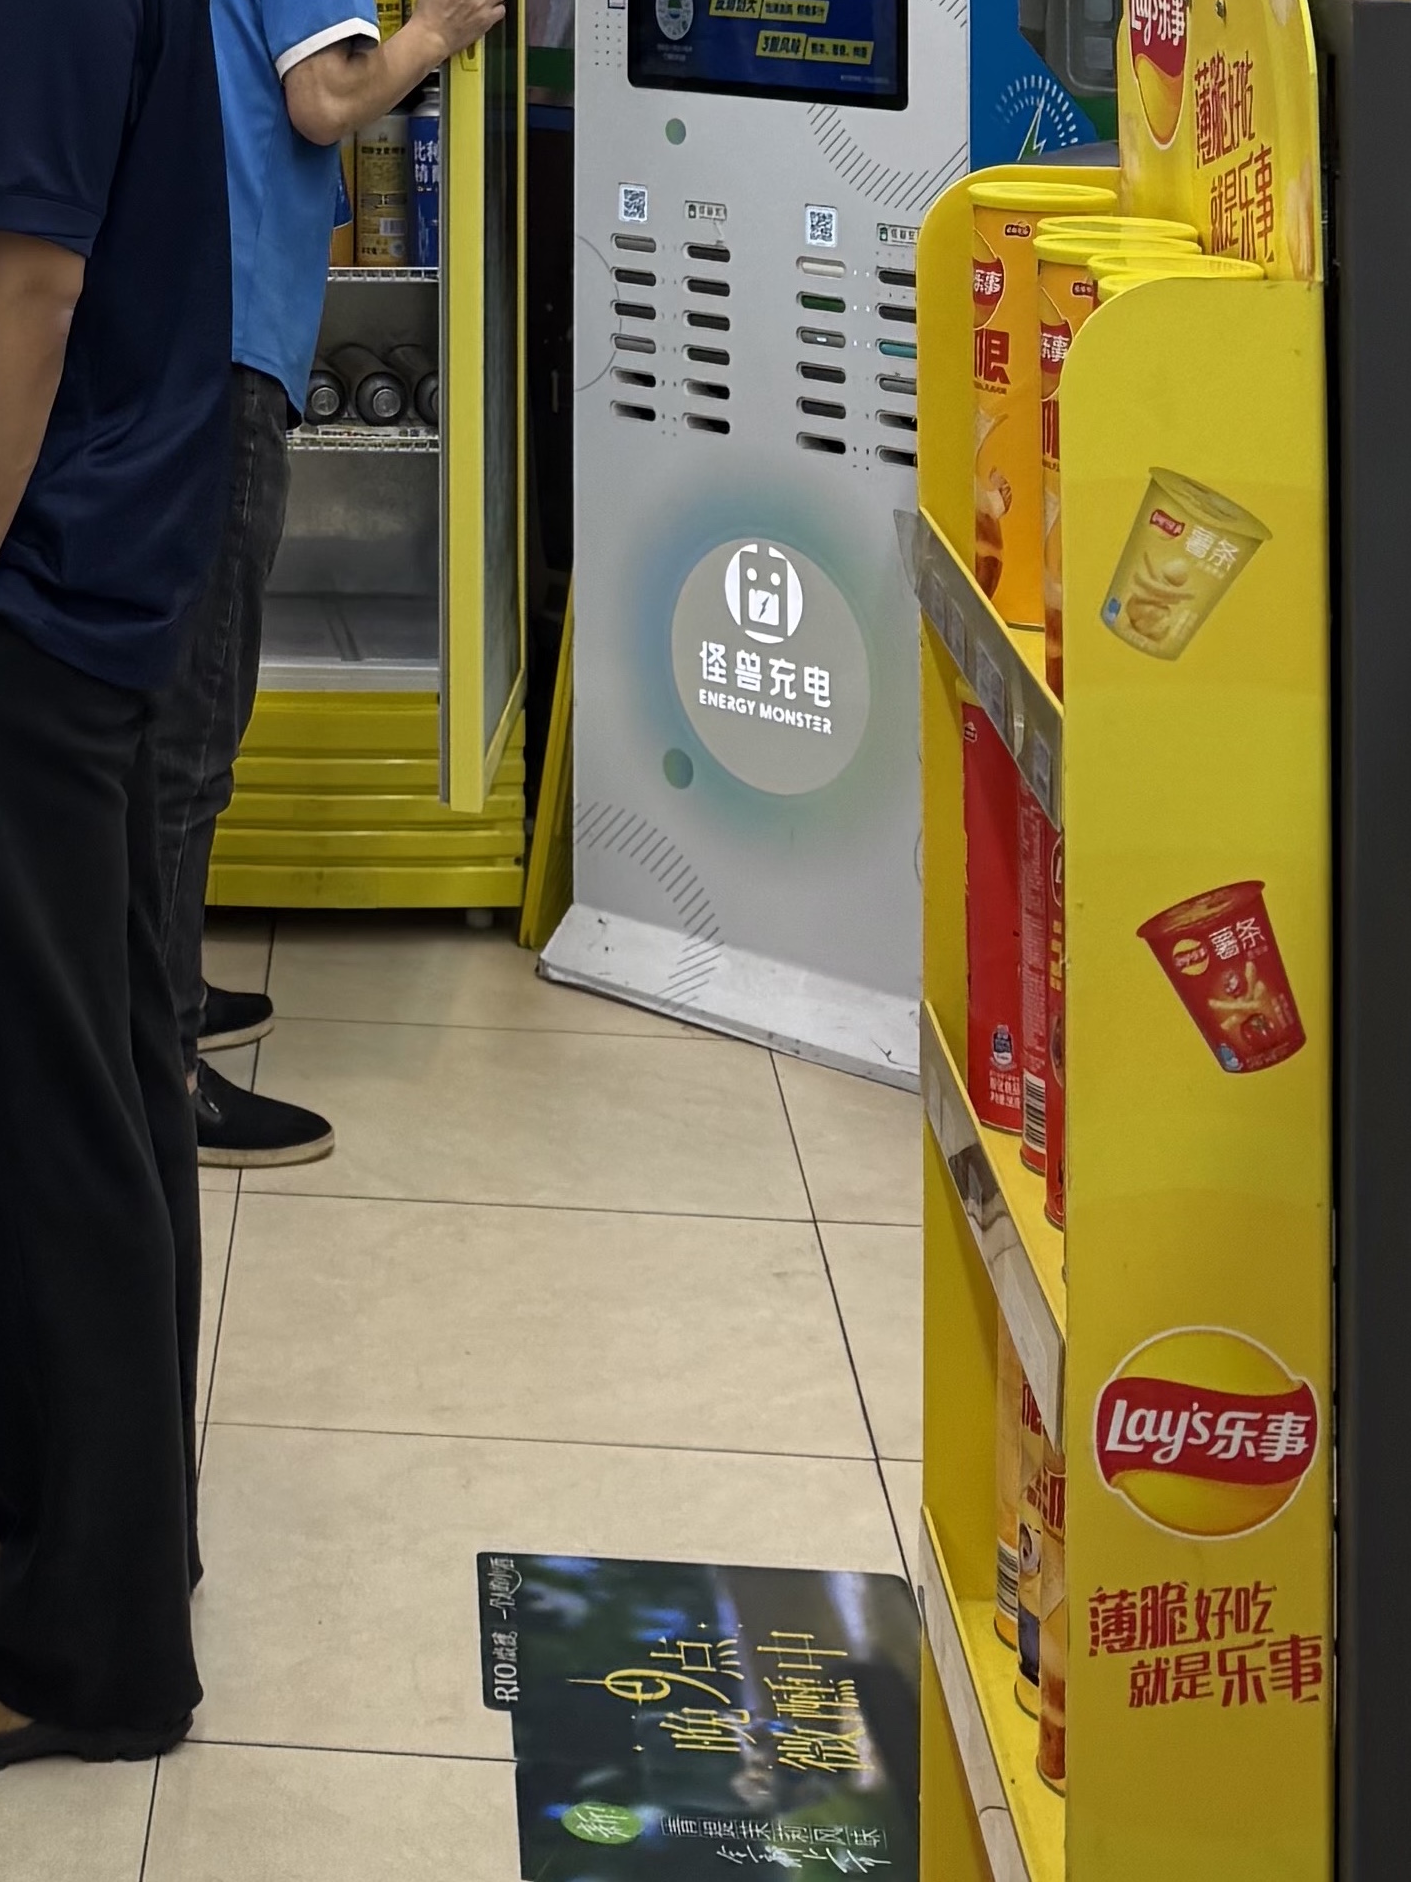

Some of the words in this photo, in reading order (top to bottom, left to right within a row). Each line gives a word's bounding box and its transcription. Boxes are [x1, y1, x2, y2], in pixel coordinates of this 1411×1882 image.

[699, 640, 832, 708] 怪兽充电
[699, 688, 755, 716] ENERGY
[759, 701, 833, 735] MONSTER
[1209, 917, 1262, 961] 薯条
[1089, 1580, 1278, 1657] 薄脆好吃
[1129, 1633, 1324, 1709] 就是乐事
